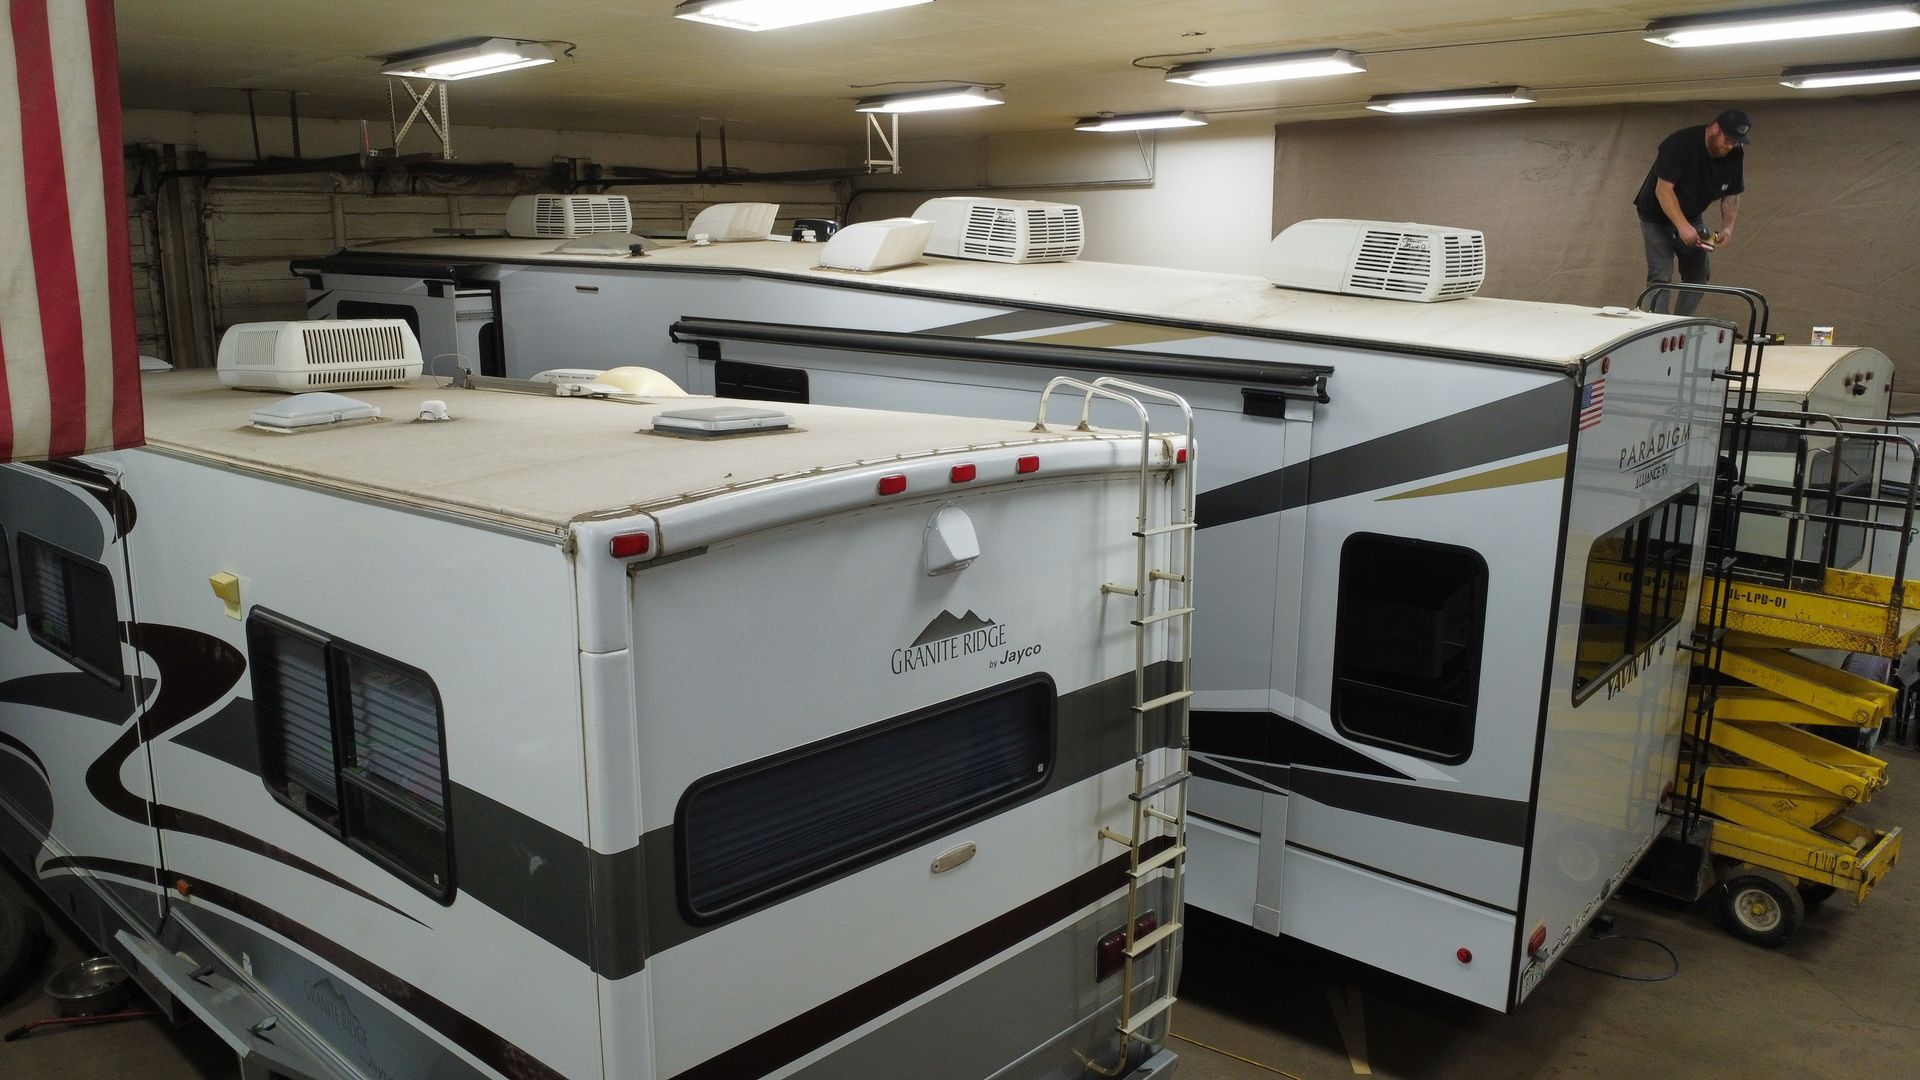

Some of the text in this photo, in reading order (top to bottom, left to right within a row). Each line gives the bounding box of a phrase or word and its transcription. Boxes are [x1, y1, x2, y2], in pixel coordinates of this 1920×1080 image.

[1619, 421, 1691, 470] PARADIGM
[1634, 465, 1662, 489] ALLIANCE
[890, 624, 1007, 675] GRANITE RIDGE
[989, 644, 1042, 669] by Jayco
[1607, 656, 1640, 702] YAVIN
